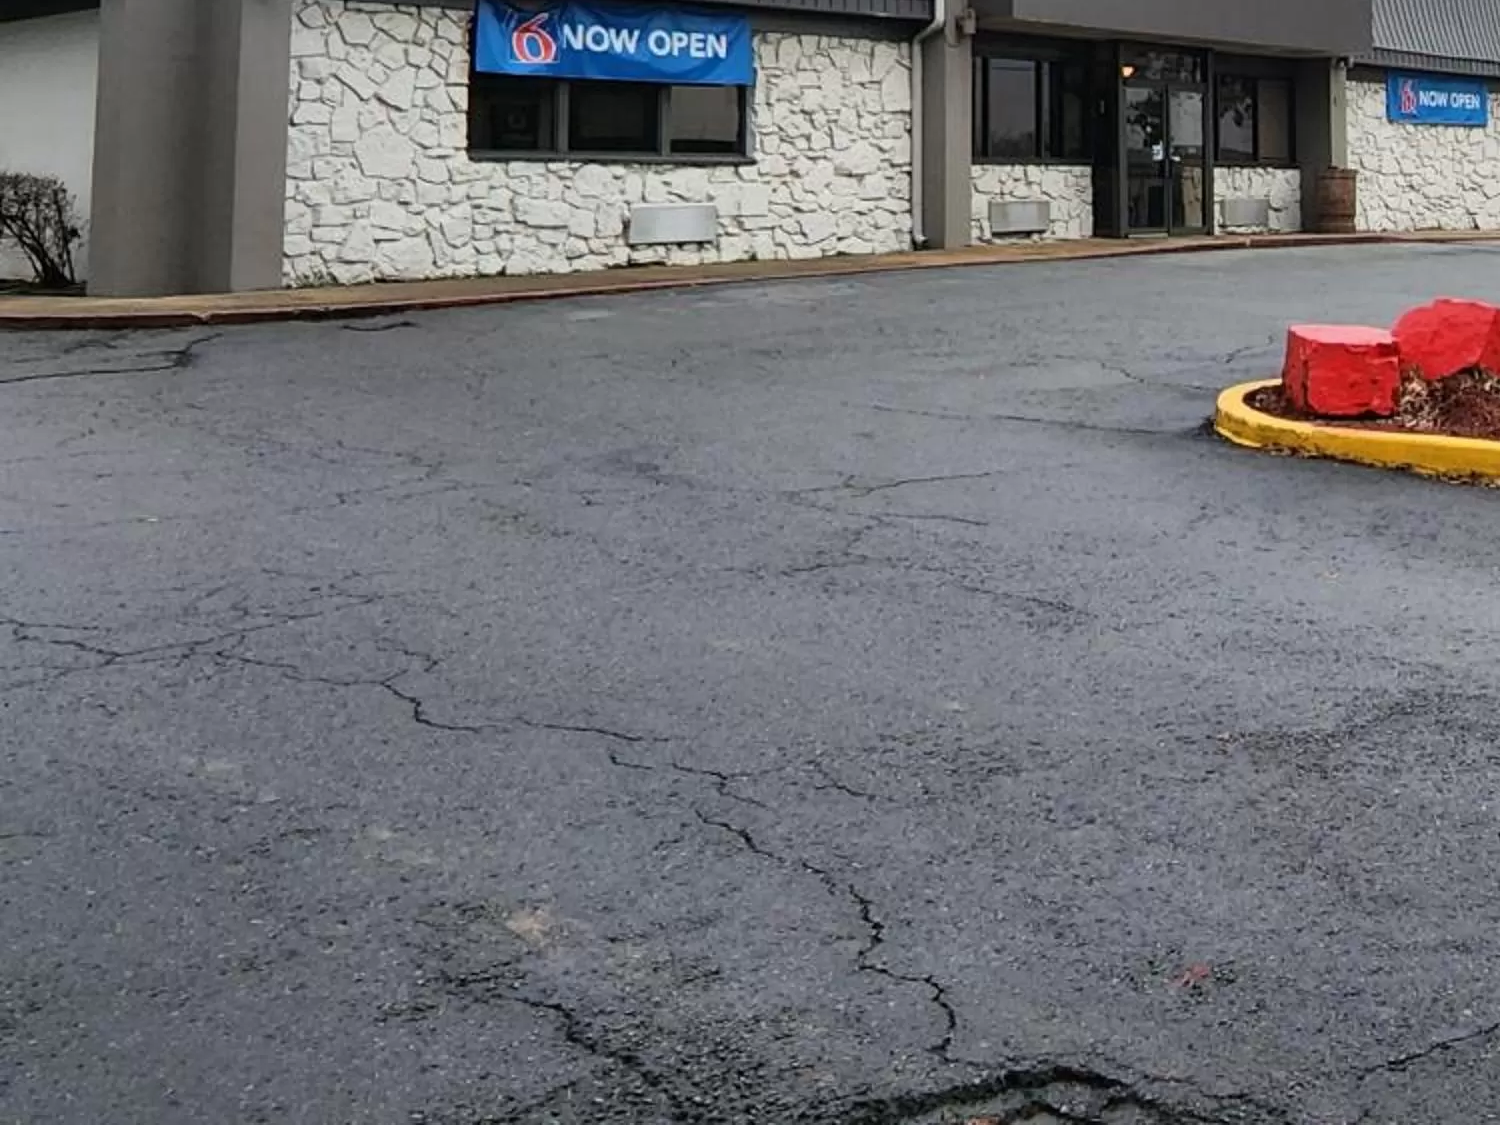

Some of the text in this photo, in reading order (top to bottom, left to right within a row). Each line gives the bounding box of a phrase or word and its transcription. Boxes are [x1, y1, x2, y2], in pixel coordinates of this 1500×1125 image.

[512, 12, 557, 63] 6
[563, 25, 640, 54] NOW
[648, 29, 728, 59] OPEN
[1419, 91, 1448, 107] NOW
[1450, 92, 1480, 109] OPEN
